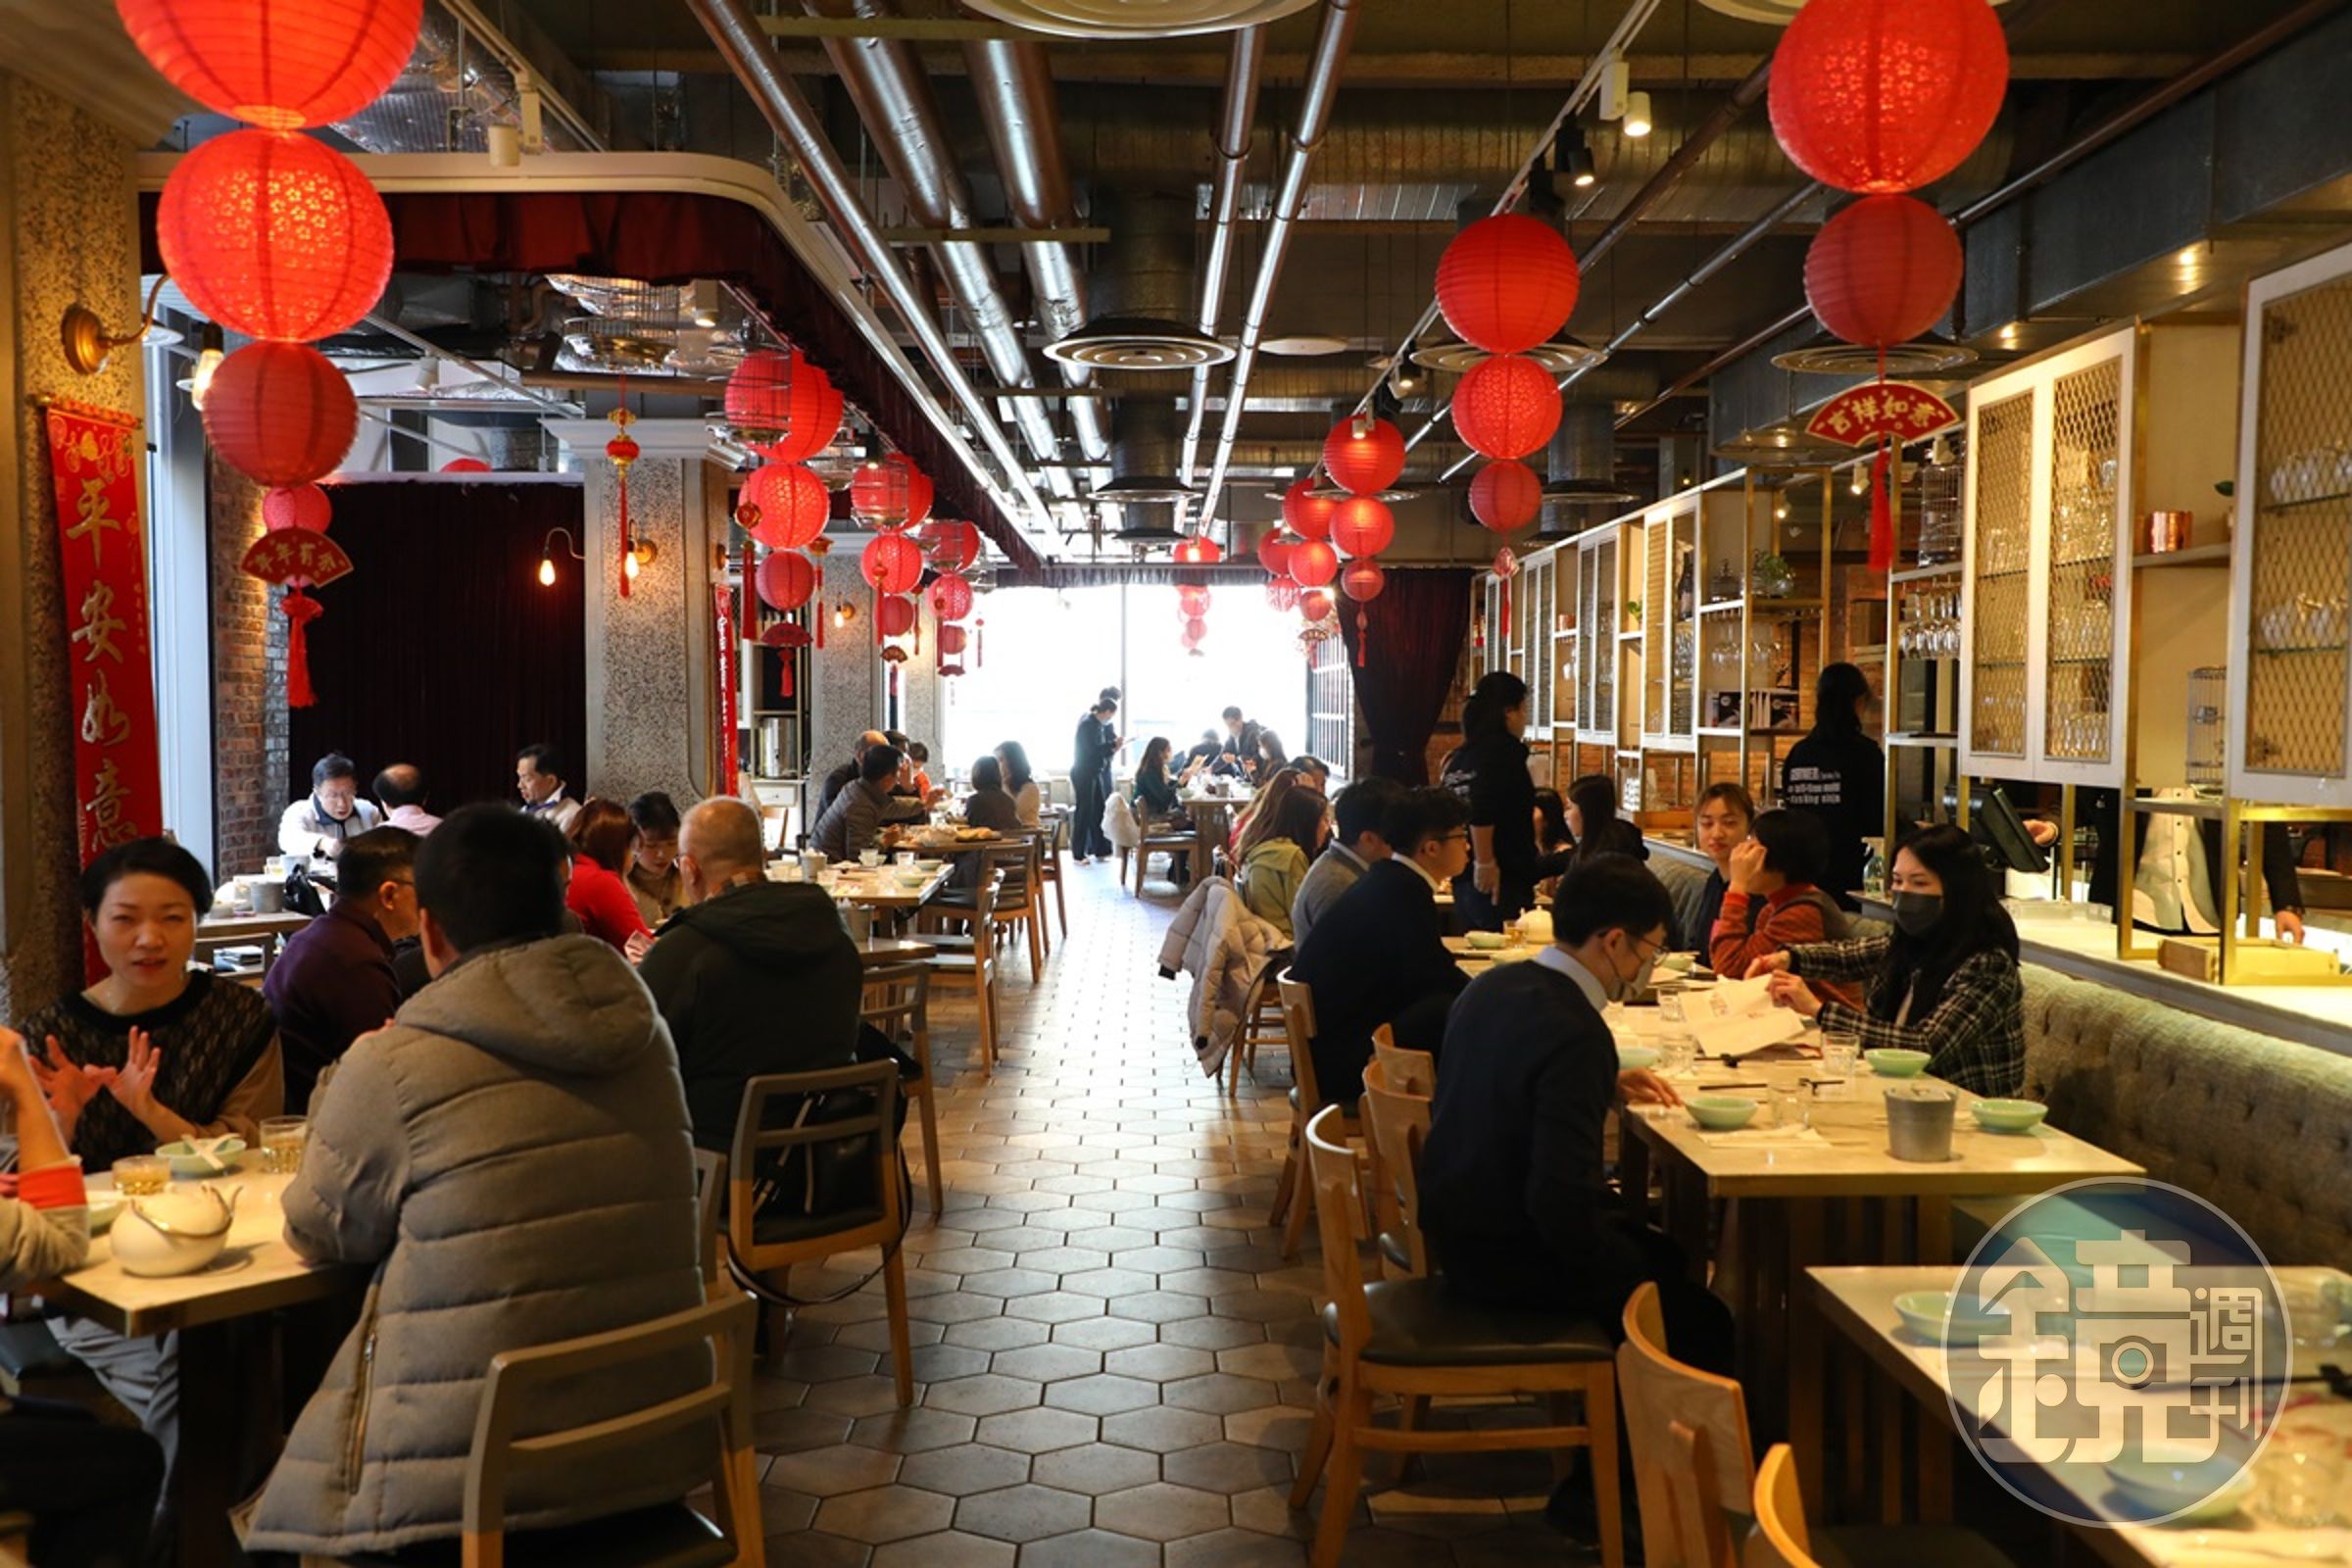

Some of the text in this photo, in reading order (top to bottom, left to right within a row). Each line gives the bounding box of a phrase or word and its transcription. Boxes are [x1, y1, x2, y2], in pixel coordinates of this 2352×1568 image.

[1828, 395, 1936, 434] 吉祥如意
[67, 477, 138, 853] 平安如意
